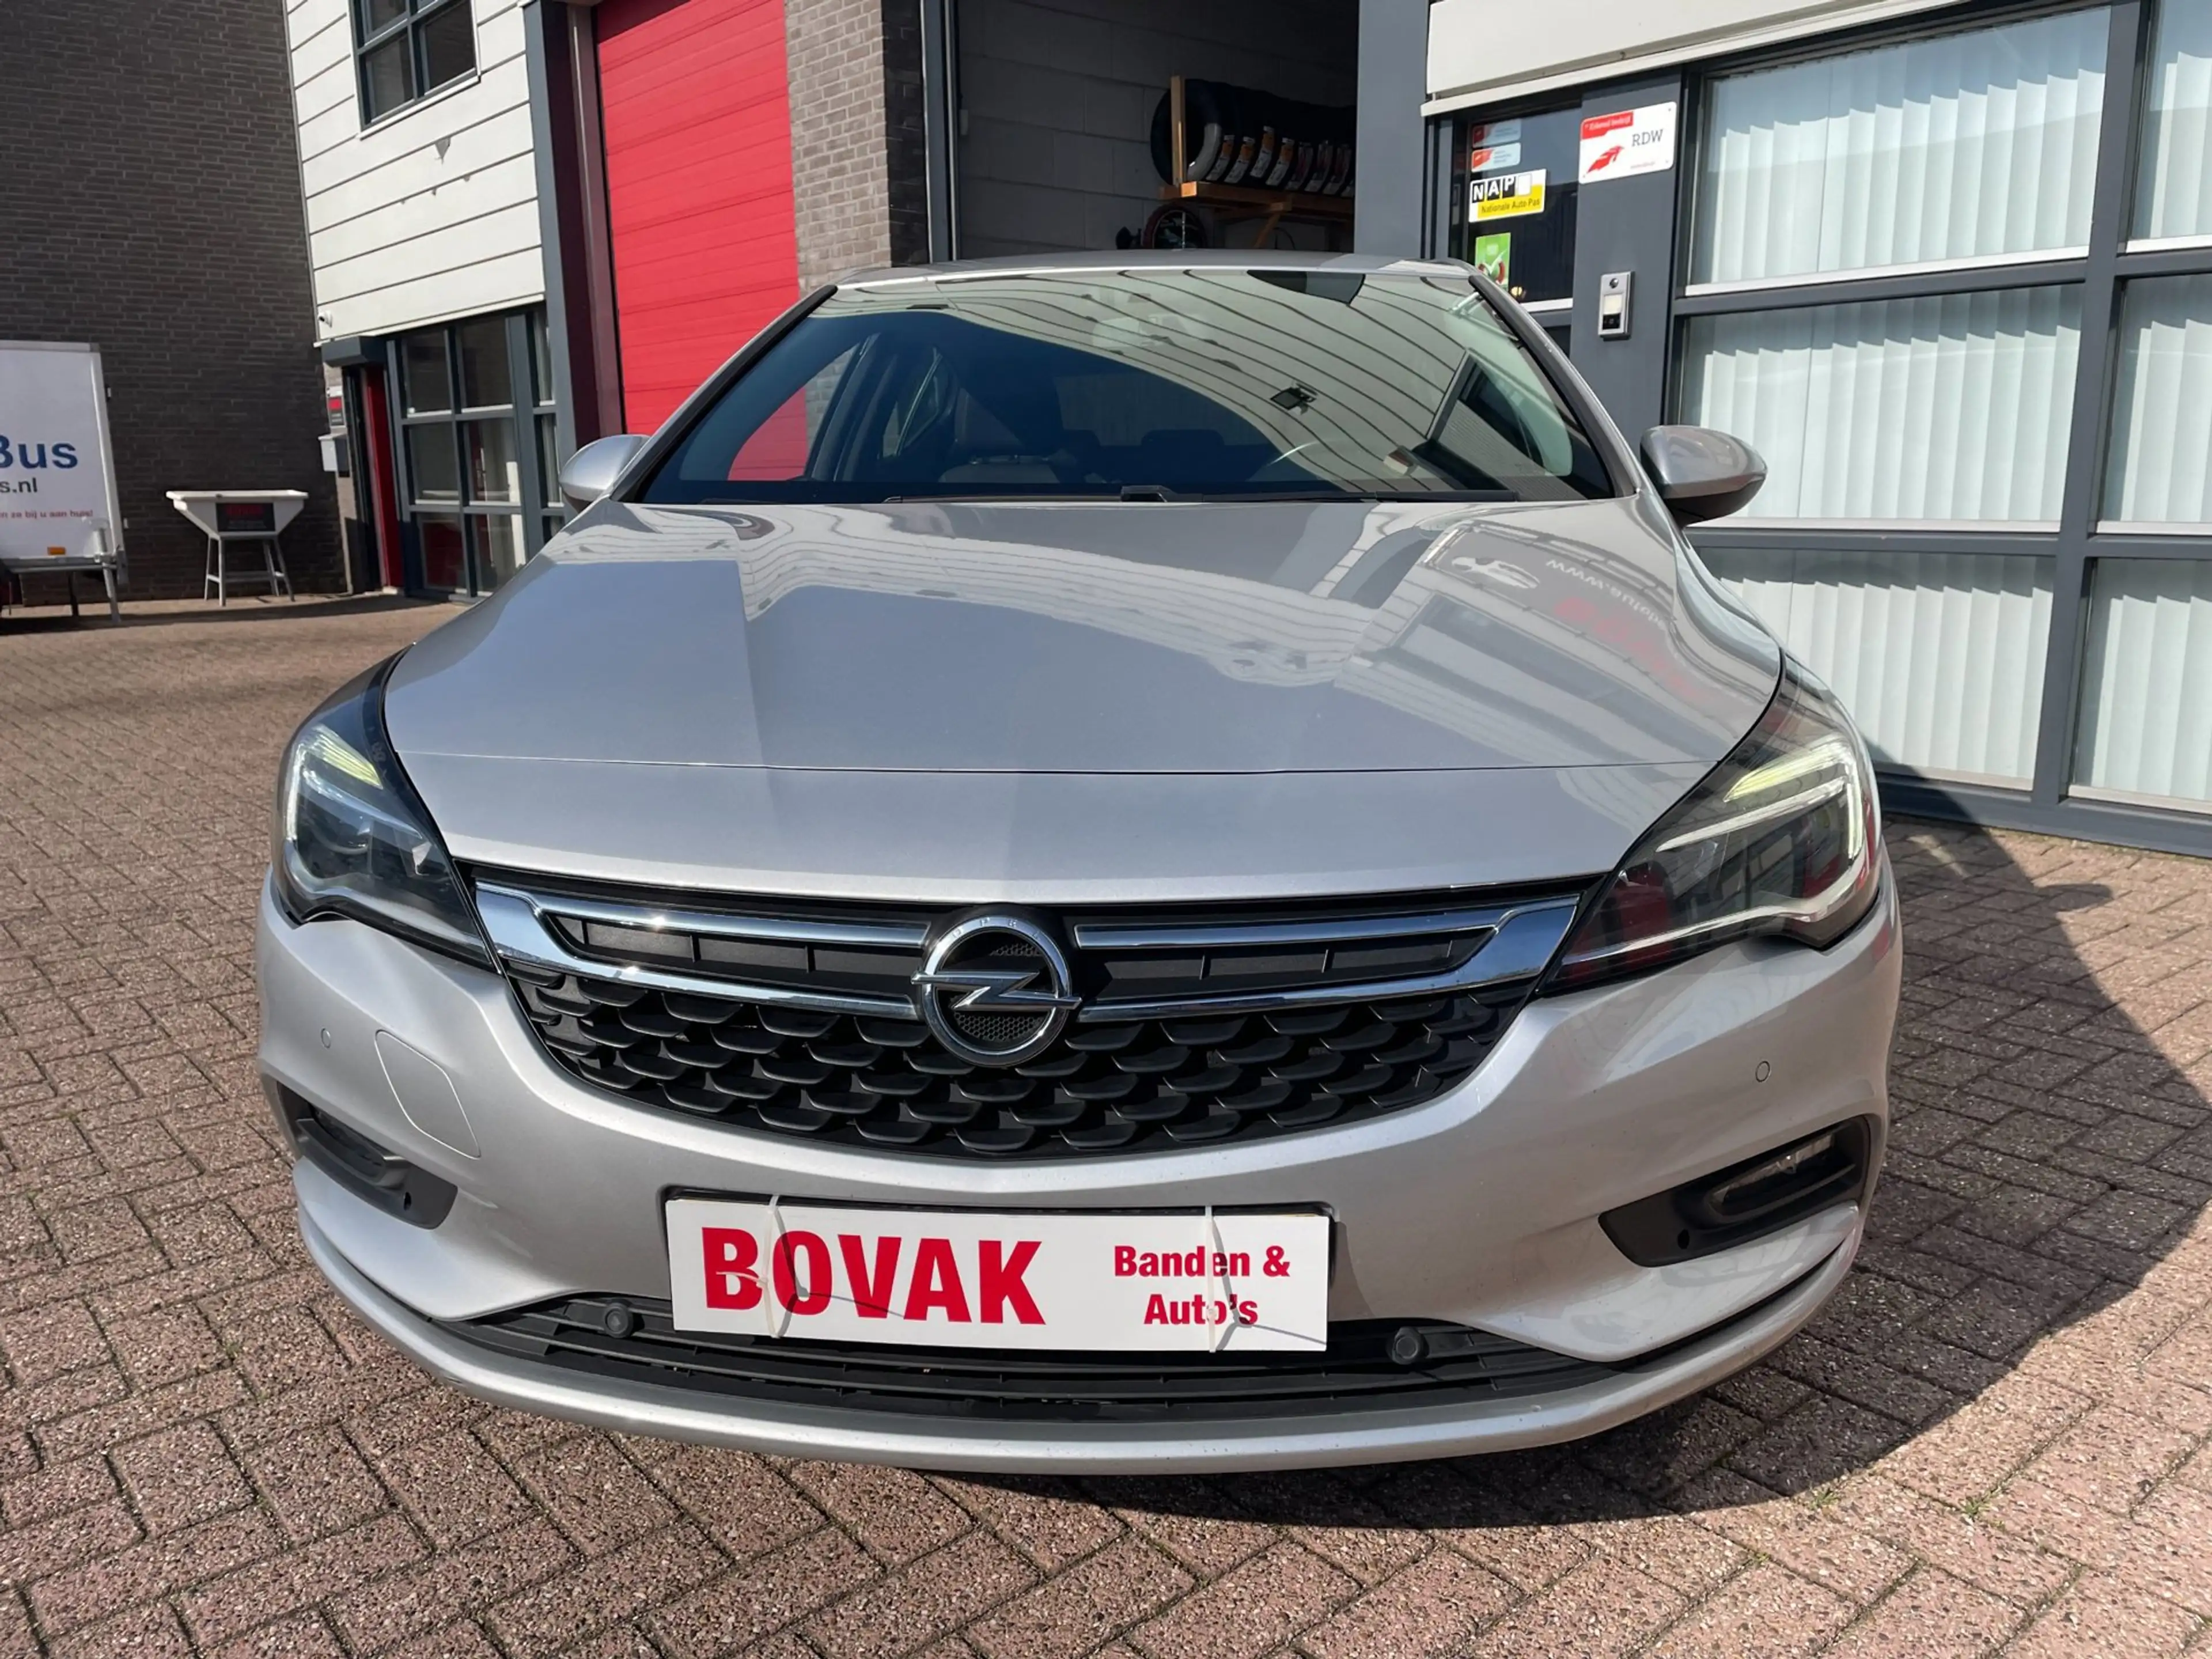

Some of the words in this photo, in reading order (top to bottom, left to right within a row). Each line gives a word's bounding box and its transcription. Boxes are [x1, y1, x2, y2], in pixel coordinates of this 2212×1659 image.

[1632, 129, 1663, 147] RDW
[1473, 176, 1515, 202] NAP
[1482, 203, 1510, 214] Nationale
[1512, 200, 1527, 209] Auto
[1528, 198, 1540, 207] Pas
[1115, 1245, 1250, 1277] Banden
[1263, 1245, 1290, 1277] &
[702, 1227, 1046, 1325] BOVAK
[1143, 1294, 1258, 1325] Auto's
